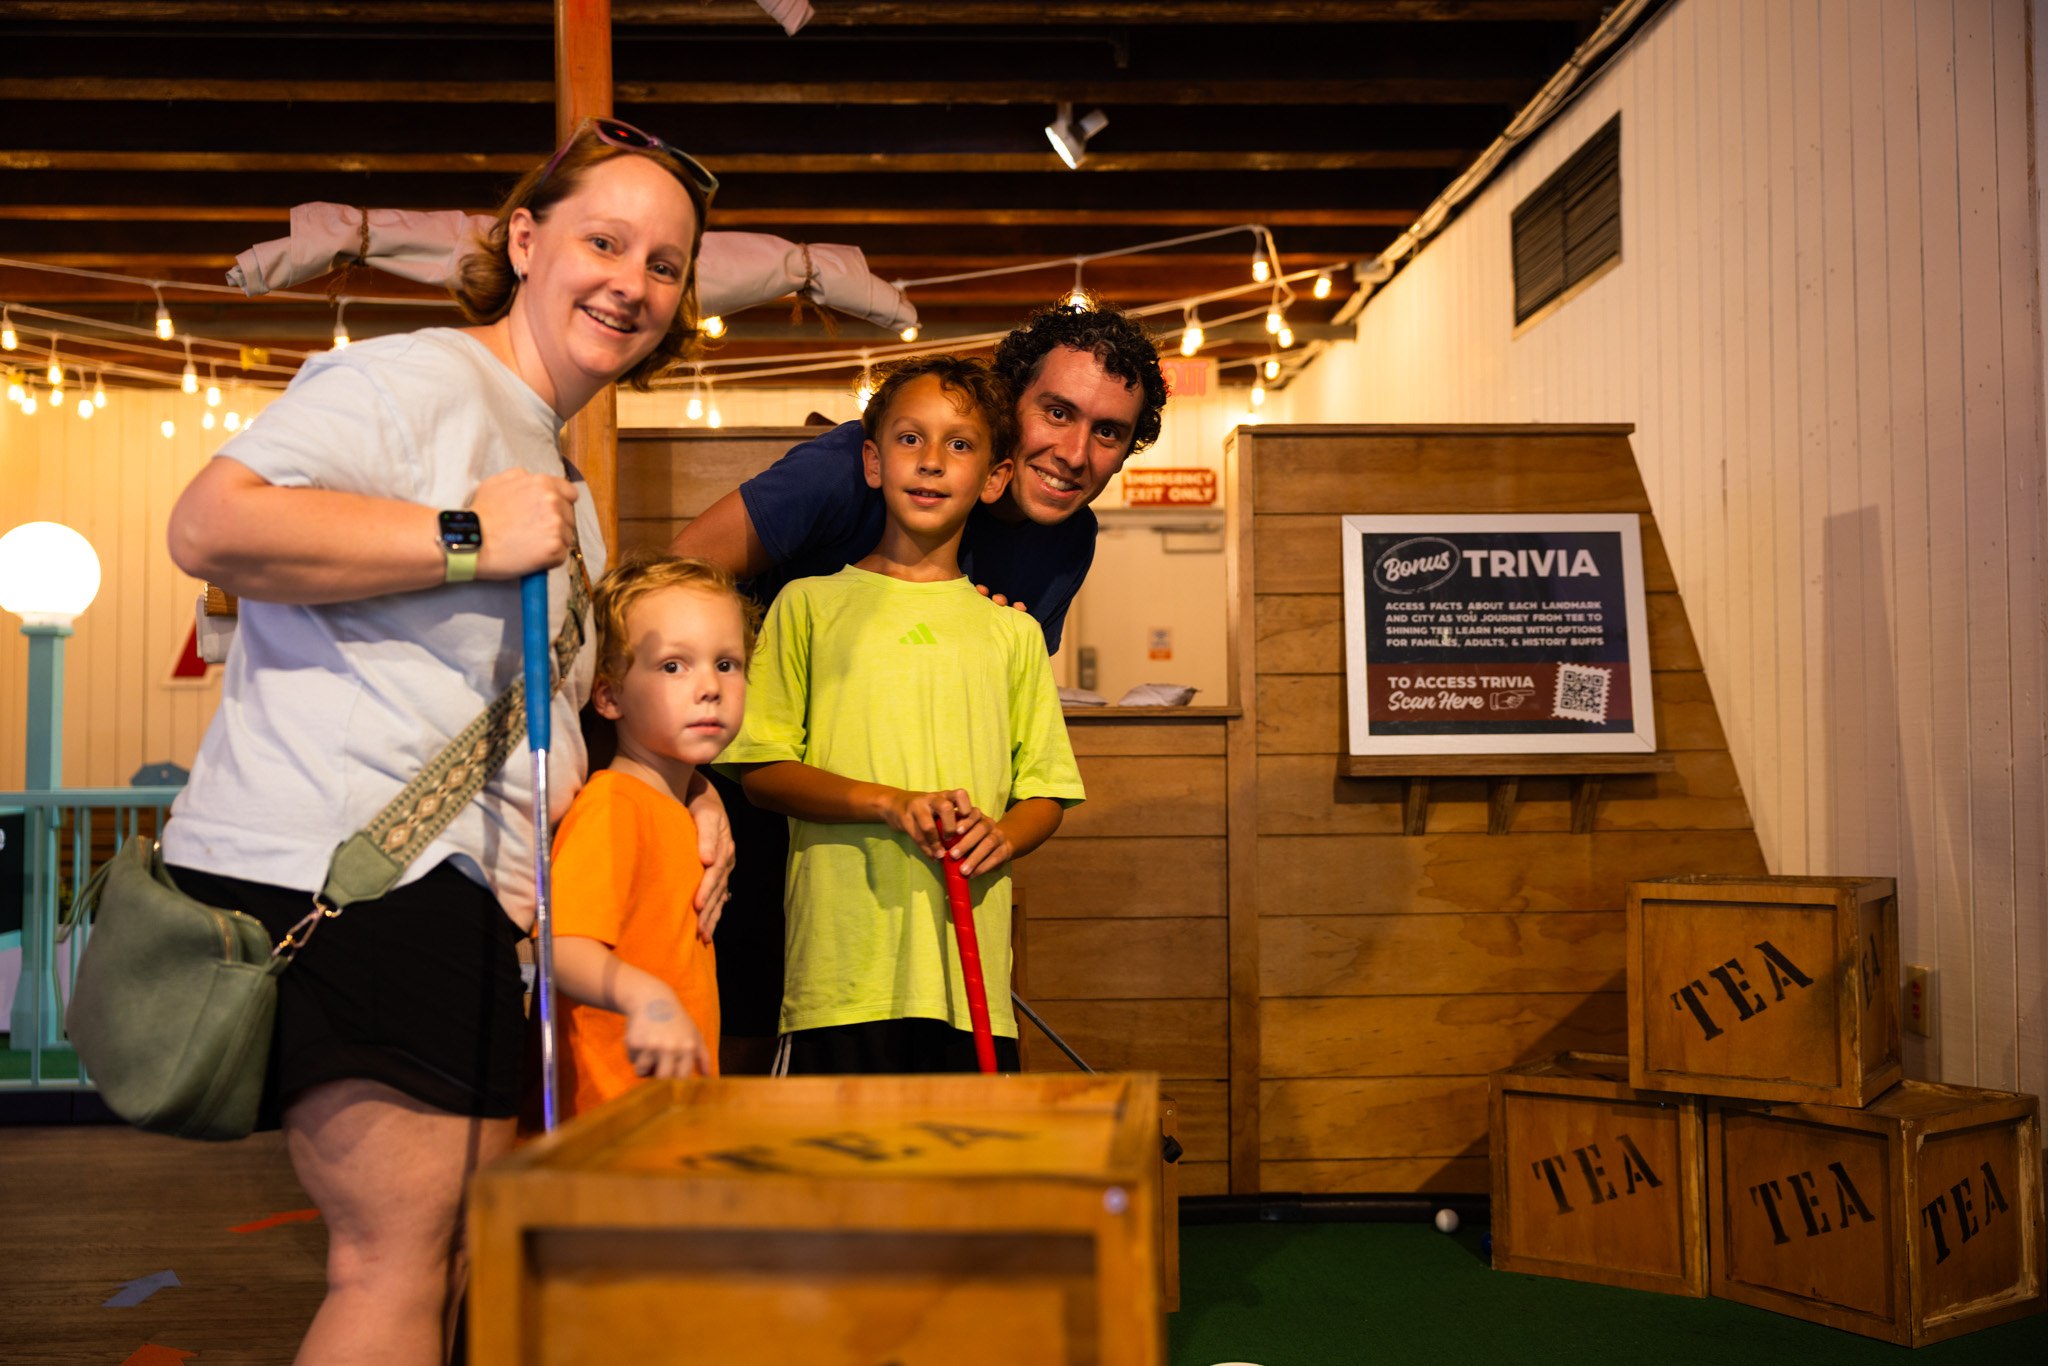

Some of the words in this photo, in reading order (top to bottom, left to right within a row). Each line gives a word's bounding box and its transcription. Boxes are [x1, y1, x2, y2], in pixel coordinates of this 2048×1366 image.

[1383, 551, 1450, 582] Bonus
[1462, 549, 1600, 577] TRIVIA
[1385, 602, 1425, 611] ACCESS
[1430, 602, 1463, 611] FACTS
[1467, 602, 1504, 611] ABOUT
[1509, 602, 1538, 611] EACH
[1542, 601, 1602, 610] LANDMARK
[1385, 614, 1408, 623] AND
[1411, 614, 1435, 623] CITY
[1438, 614, 1453, 623] AS
[1456, 614, 1477, 623] YOU
[1480, 614, 1529, 623] JOURNEY
[1532, 613, 1562, 622] FROM
[1565, 613, 1584, 622] TEE
[1587, 613, 1603, 622] TO
[1386, 626, 1428, 635] SHINING
[1455, 626, 1491, 635] LEARN
[1493, 626, 1523, 635] MORE
[1526, 626, 1554, 634] WITH
[1556, 625, 1603, 634] OPTIONS
[1386, 638, 1408, 647] FOR
[1511, 638, 1519, 647] &
[1522, 638, 1567, 647] HISTORY
[1570, 637, 1604, 646] BUFFS
[1388, 677, 1411, 689] TO
[1414, 677, 1477, 689] ACCESS
[1480, 676, 1535, 688] TRIVIA
[1388, 691, 1436, 712] Scan
[1437, 690, 1485, 710] Here
[1669, 940, 1814, 1041] TEA
[1531, 1134, 1664, 1216] TEA
[1748, 1161, 1876, 1246] TEA
[1921, 1161, 2009, 1266] TEA
